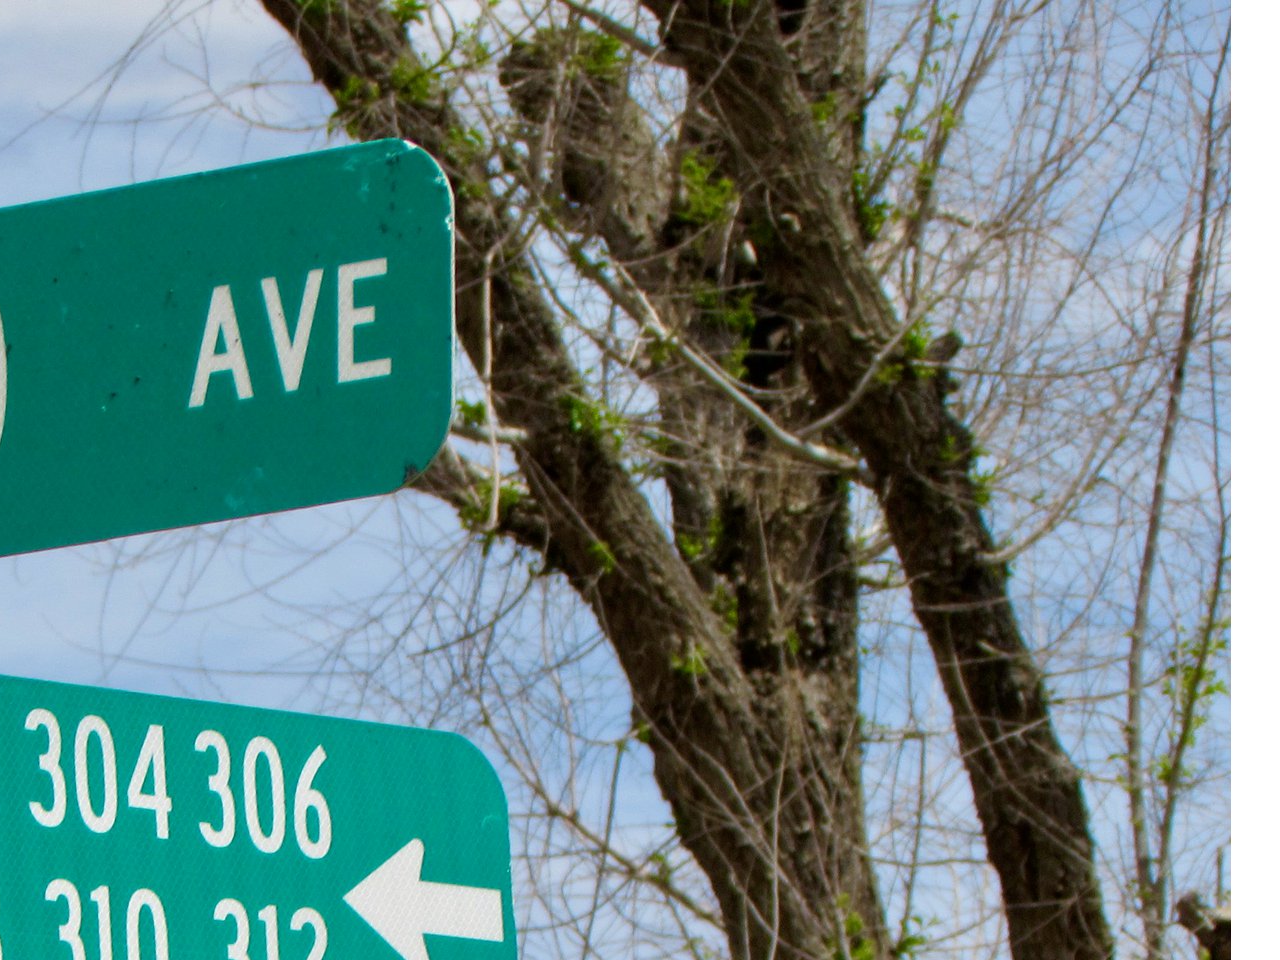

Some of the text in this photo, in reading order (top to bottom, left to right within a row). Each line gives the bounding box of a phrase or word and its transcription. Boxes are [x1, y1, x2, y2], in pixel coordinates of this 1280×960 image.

[189, 259, 391, 408] AVE
[24, 708, 172, 839] 304
[195, 730, 332, 859] 306
